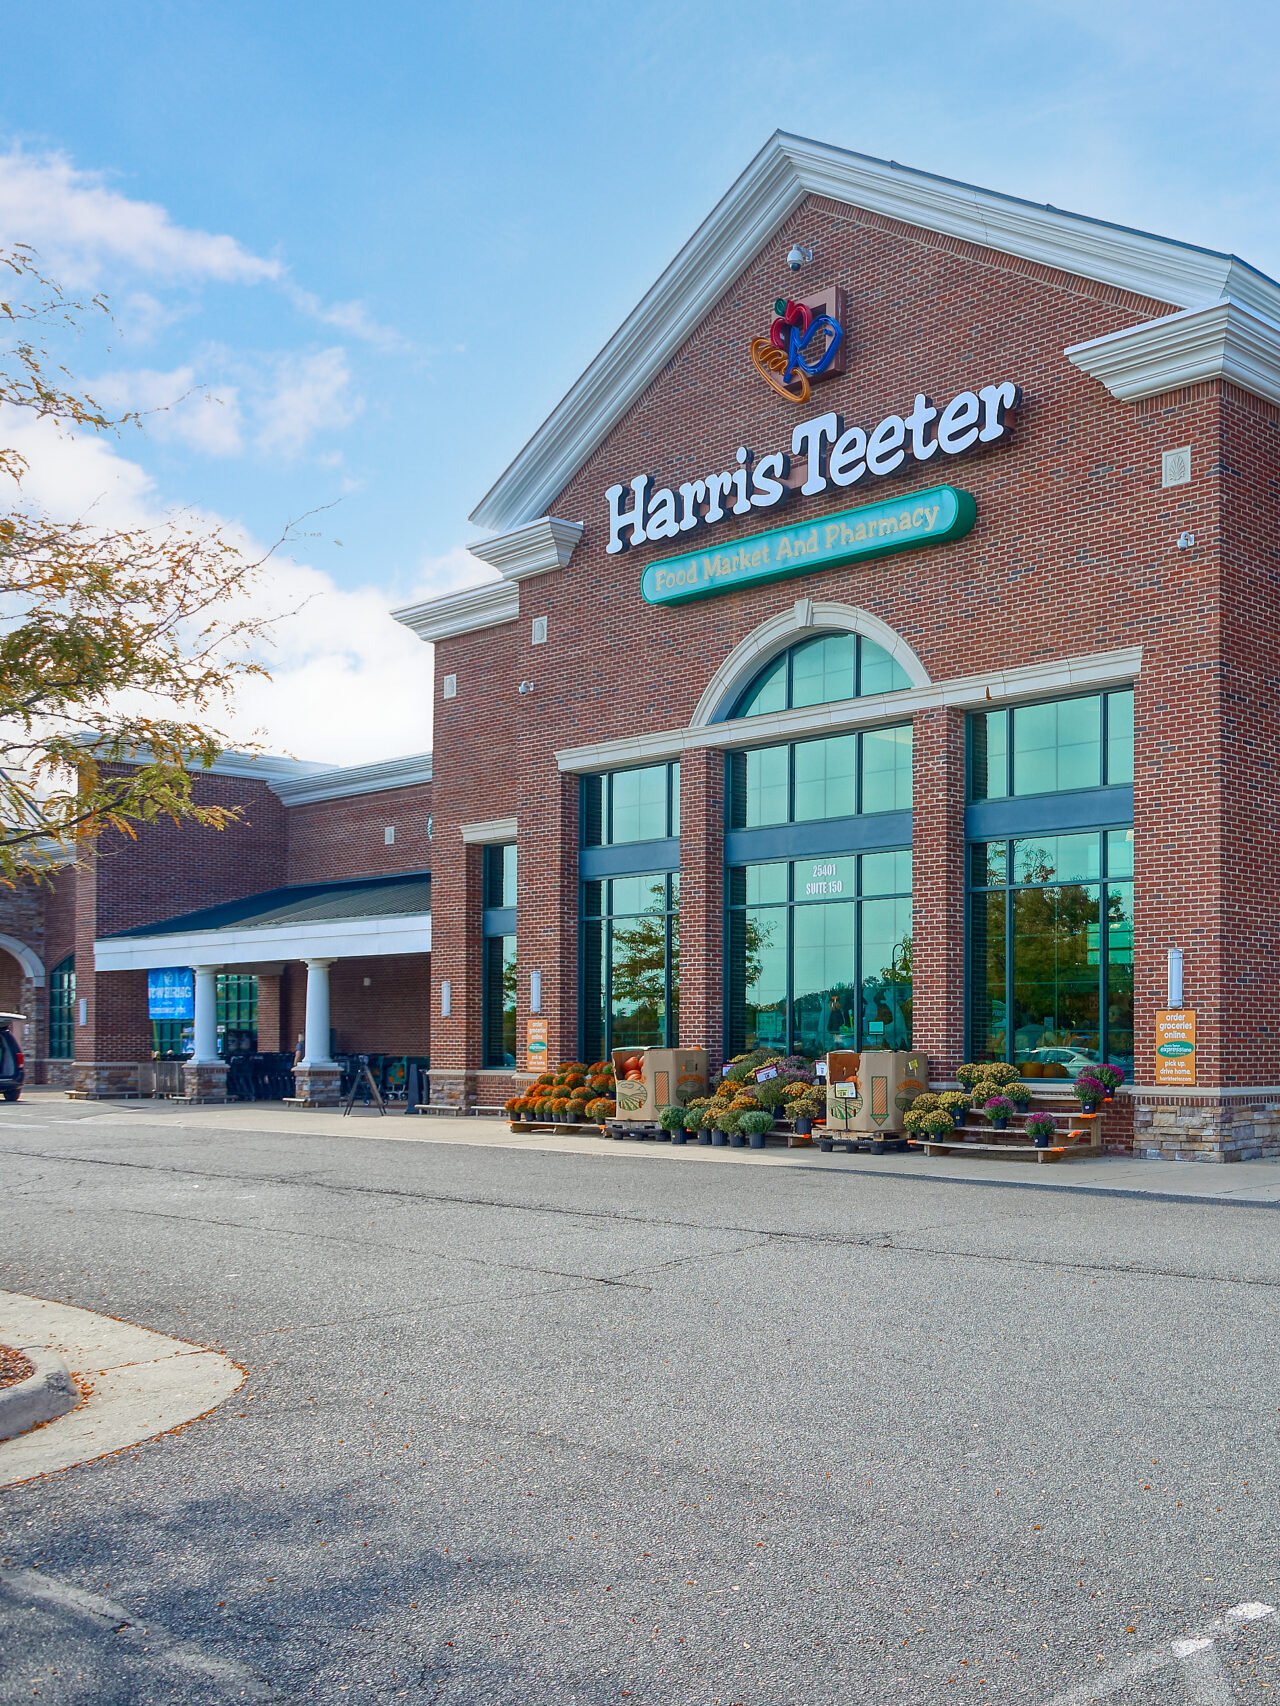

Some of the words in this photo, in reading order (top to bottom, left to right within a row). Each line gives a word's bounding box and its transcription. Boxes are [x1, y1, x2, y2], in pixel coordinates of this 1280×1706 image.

[605, 446, 784, 554] Harris
[792, 381, 1016, 496] Teeter
[655, 561, 699, 592] Food
[703, 545, 770, 580] Market
[775, 530, 819, 561] And
[825, 506, 940, 546] Pharmacy
[812, 864, 836, 877] 25401
[806, 881, 827, 895] SUITE
[829, 880, 843, 893] 150
[1166, 1013, 1185, 1021] order
[1160, 1023, 1192, 1032] groceries
